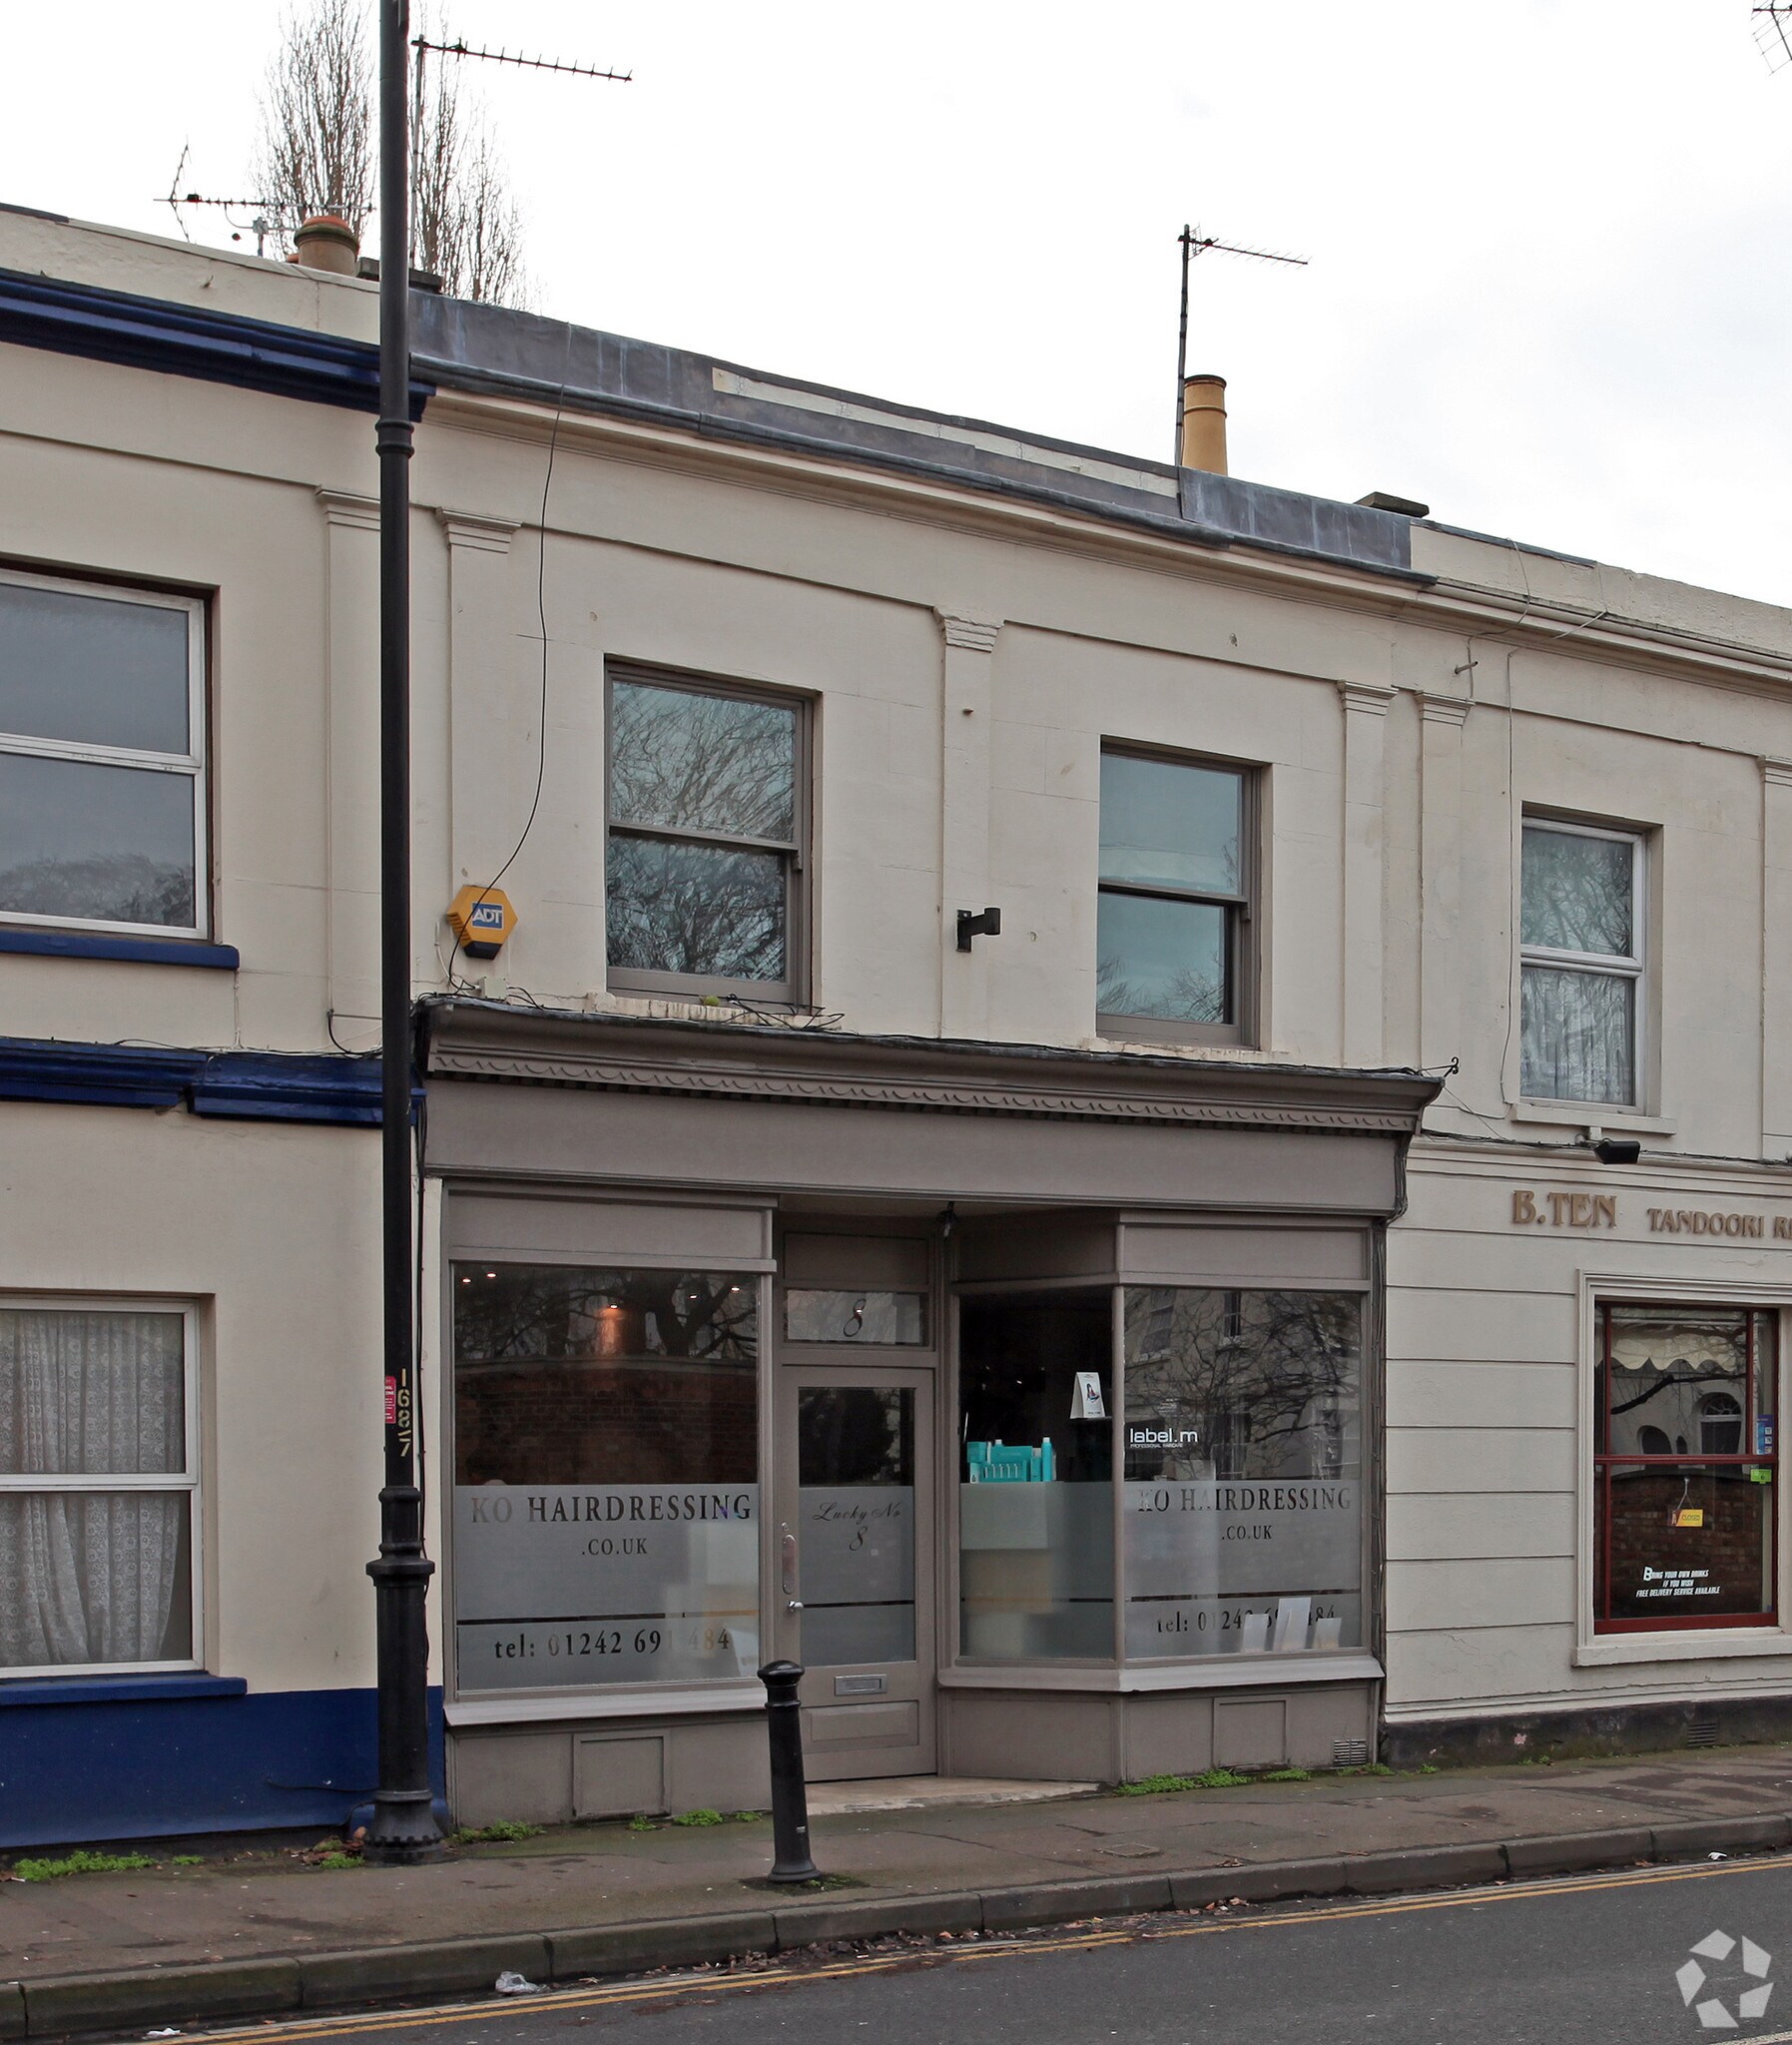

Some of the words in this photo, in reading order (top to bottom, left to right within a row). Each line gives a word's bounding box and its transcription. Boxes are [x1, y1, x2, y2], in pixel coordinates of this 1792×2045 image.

[472, 908, 503, 924] ADT
[1511, 1189, 1617, 1228] B.TEN
[1647, 1208, 1765, 1238] TANDOORI
[843, 1298, 867, 1337] 8
[1130, 1428, 1198, 1443] label.m
[471, 1497, 512, 1523] KO
[527, 1494, 751, 1523] HAIRDRESSING
[813, 1502, 867, 1525] Lucky
[849, 1526, 868, 1551] 8
[1222, 1525, 1272, 1540] .CO.UK
[581, 1538, 648, 1556] .CO.UK
[1694, 1586, 1720, 1595] AVAILABLE
[1157, 1611, 1188, 1633] tel:
[495, 1633, 535, 1659] tel:
[549, 1630, 622, 1657] 01242
